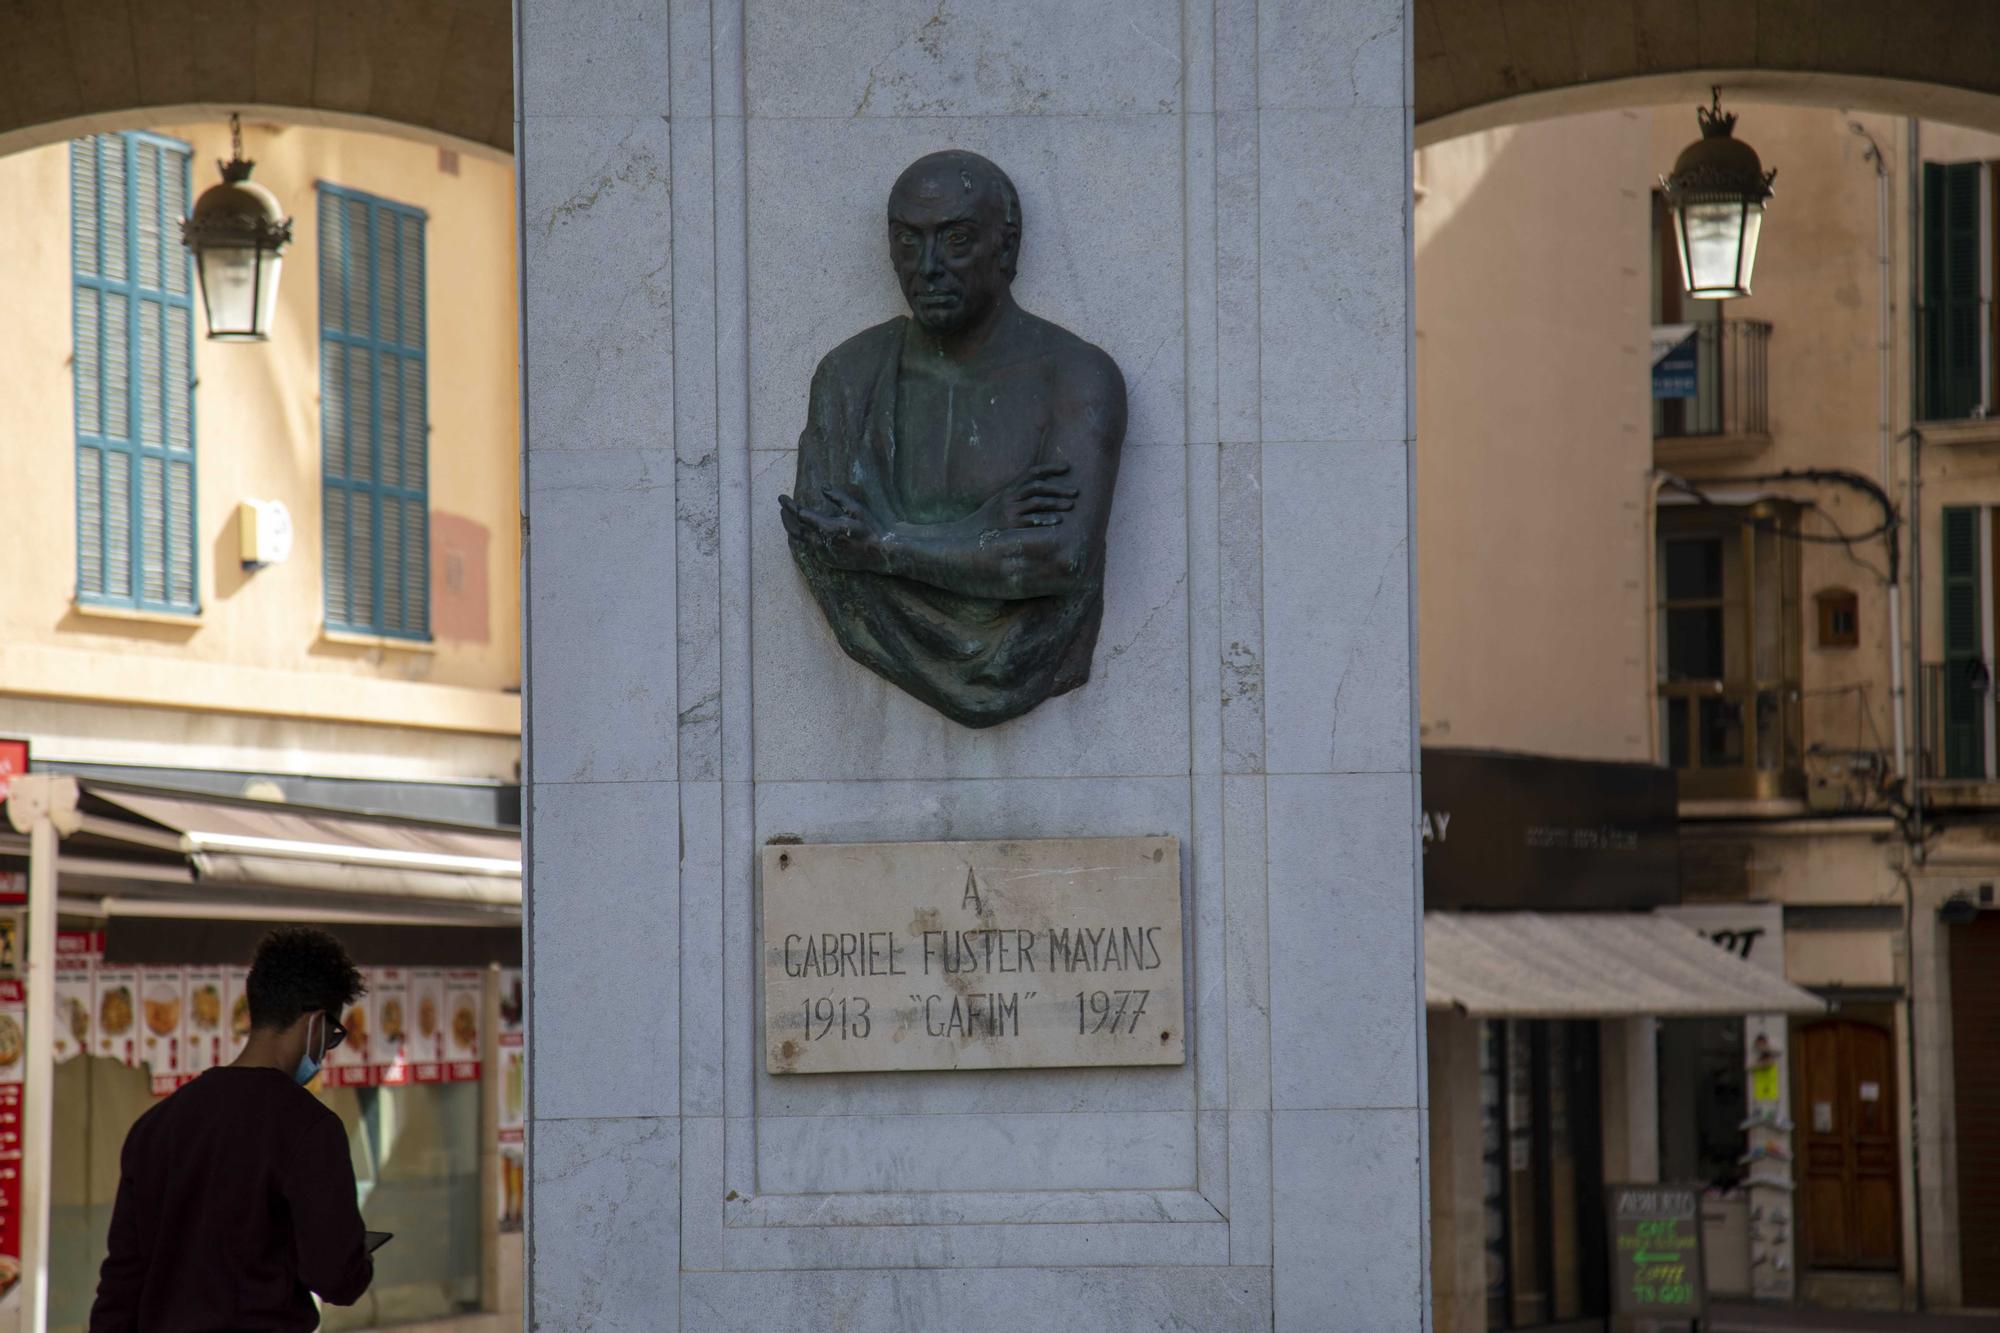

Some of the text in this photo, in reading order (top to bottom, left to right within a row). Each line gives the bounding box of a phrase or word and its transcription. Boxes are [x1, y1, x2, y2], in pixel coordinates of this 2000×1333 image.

[961, 866, 983, 916] A
[784, 926, 1161, 978] GABRIEL FUSTER MAYANS
[801, 995, 871, 1041] 1913
[1075, 990, 1150, 1035] 1977
